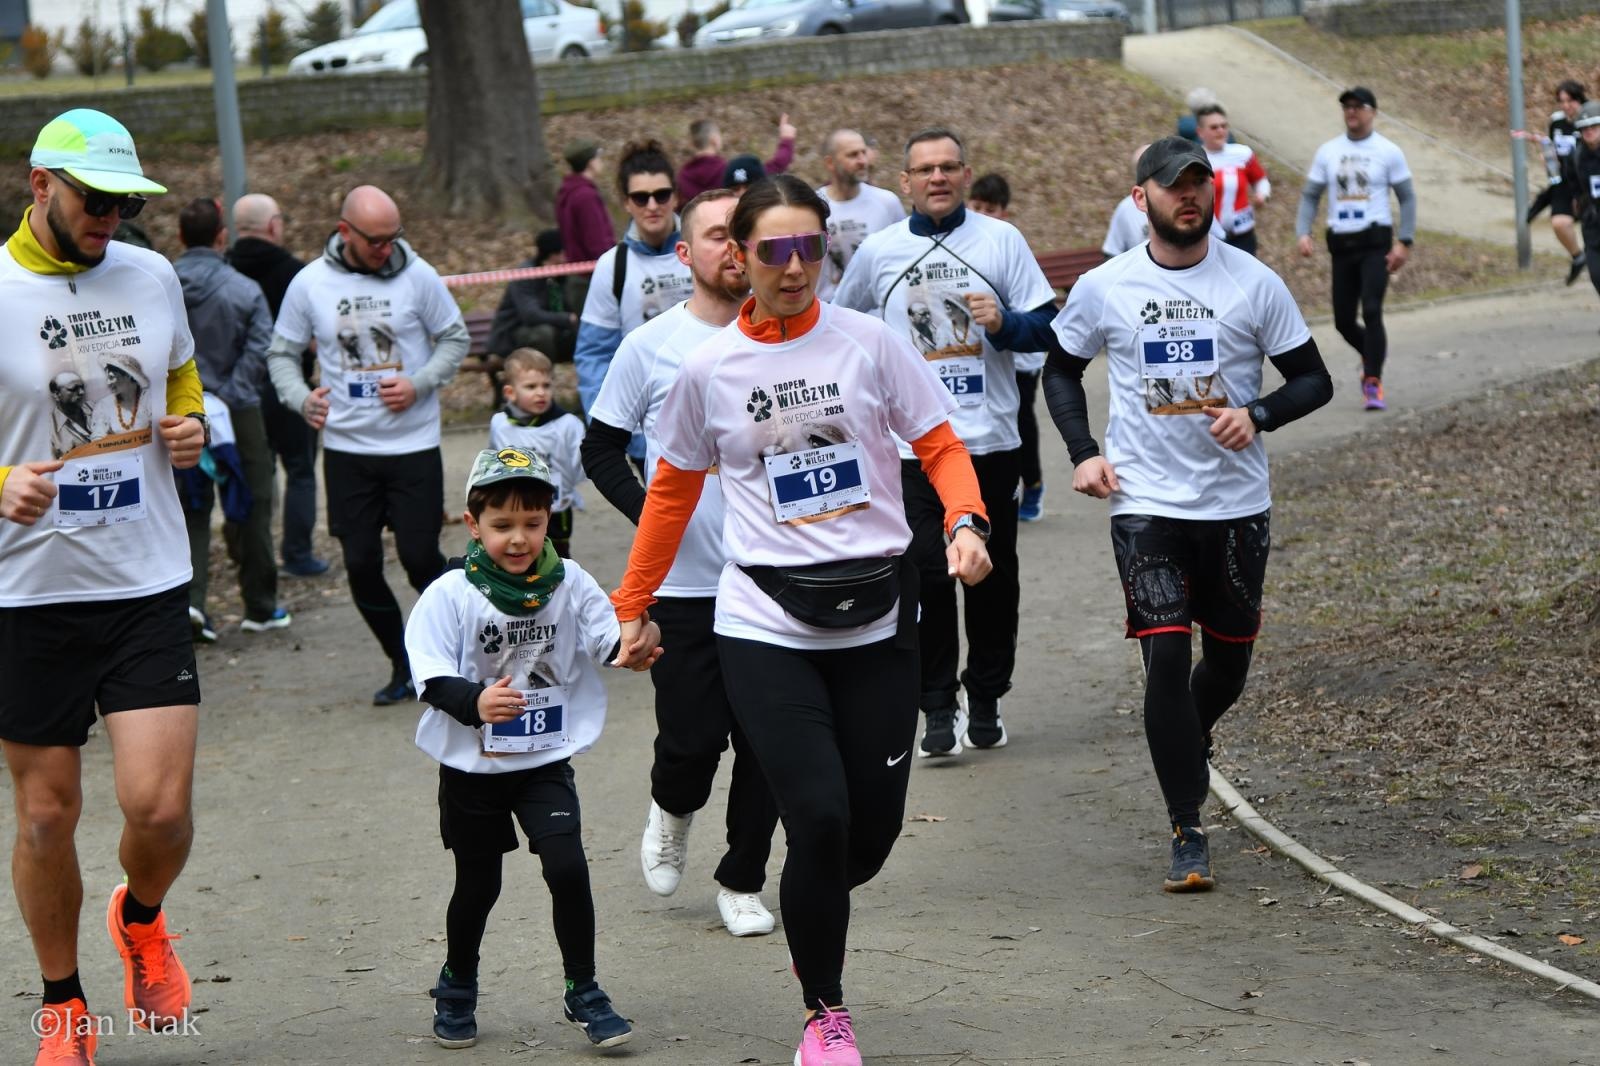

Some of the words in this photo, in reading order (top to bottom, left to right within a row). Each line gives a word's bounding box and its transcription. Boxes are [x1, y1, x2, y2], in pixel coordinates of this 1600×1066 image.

[926, 262, 948, 270] TROPEM
[926, 267, 969, 281] WILCZYM
[67, 310, 102, 324] TROPEM
[1165, 307, 1214, 320] WILCZYM
[71, 315, 136, 339] WILCZYM
[1170, 329, 1196, 338] WILCZYM
[91, 339, 121, 352] EDYCJA
[120, 336, 141, 347] 2026
[1165, 341, 1195, 362] 98
[773, 378, 806, 394] TROPEM
[945, 376, 969, 394] 15
[776, 382, 840, 409] WILCZYM
[781, 413, 794, 425] XIV
[794, 409, 824, 423] EDYCJA
[824, 404, 845, 417] 2026
[804, 451, 837, 466] WILCZYM
[92, 470, 122, 482] WILCZYM
[803, 467, 837, 496] 19
[87, 484, 120, 509] 17
[835, 598, 855, 611] 4F
[506, 619, 536, 630] TROPEM
[507, 622, 559, 645] WILCZYM
[519, 709, 547, 735] 18
